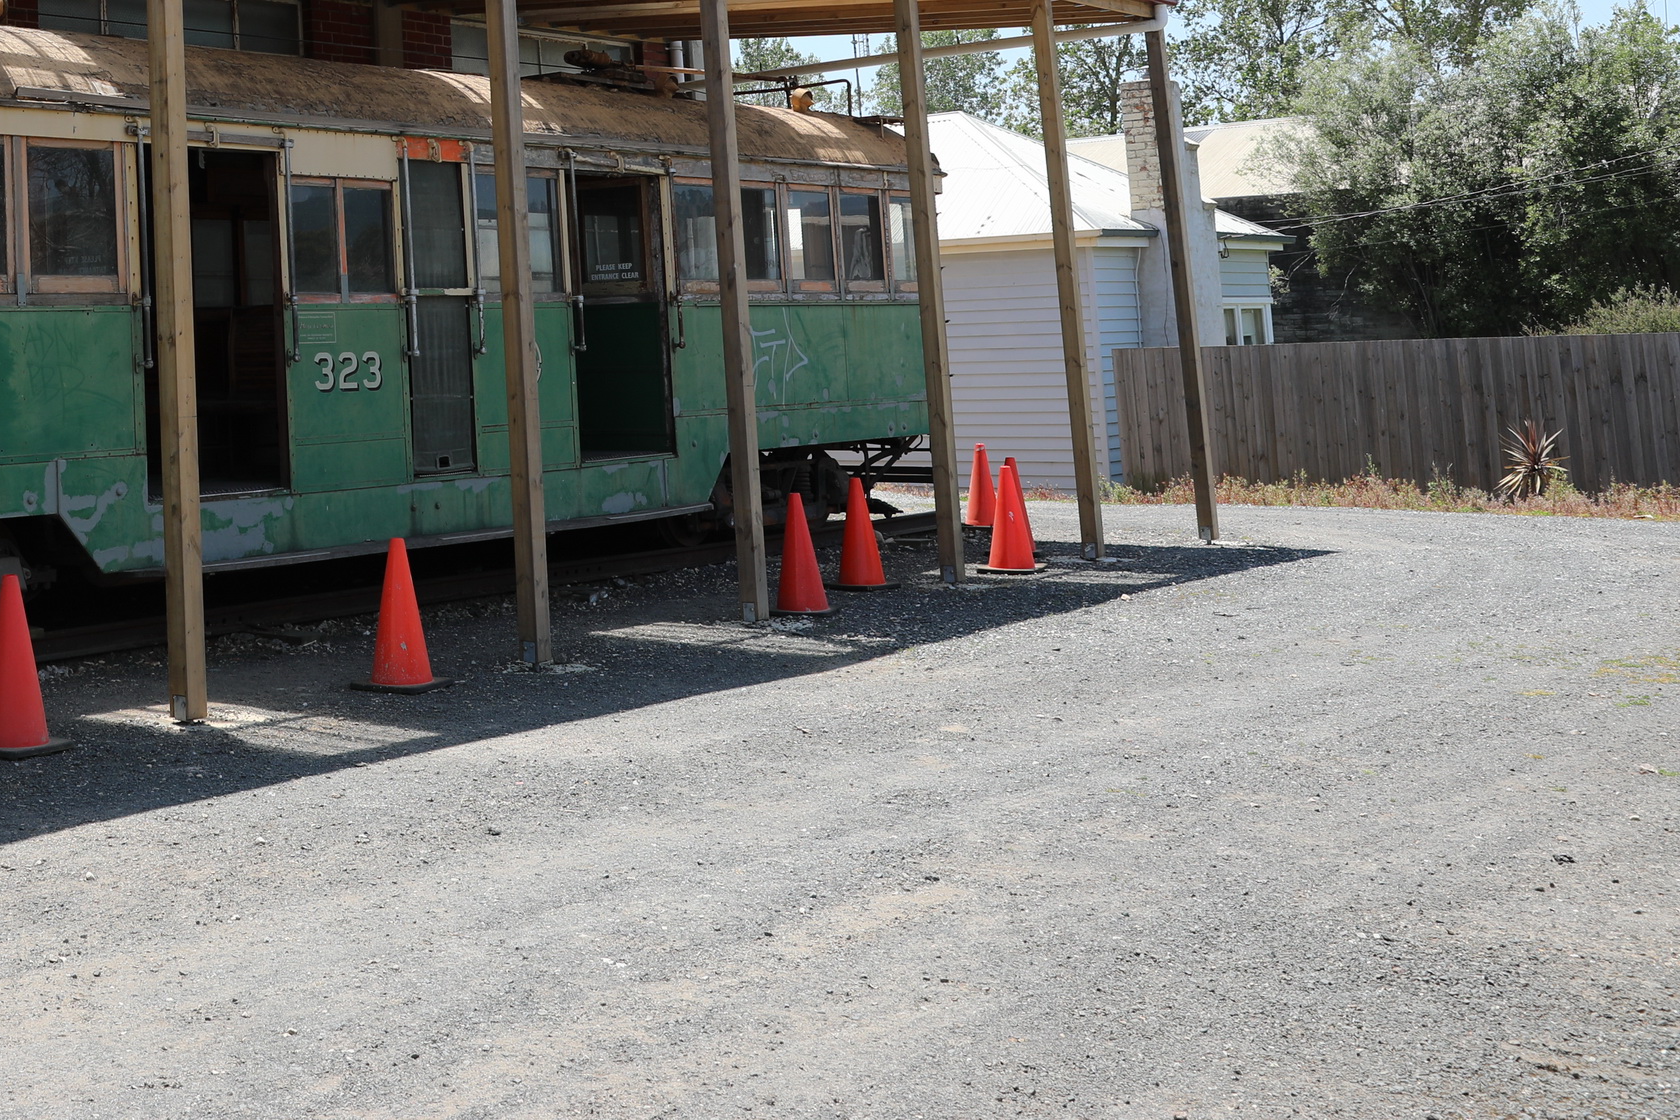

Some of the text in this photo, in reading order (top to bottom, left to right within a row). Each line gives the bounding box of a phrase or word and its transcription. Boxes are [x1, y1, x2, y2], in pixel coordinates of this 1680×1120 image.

[617, 262, 632, 270] KEEP
[591, 273, 619, 281] ENTRANCE
[314, 351, 382, 391] 323
